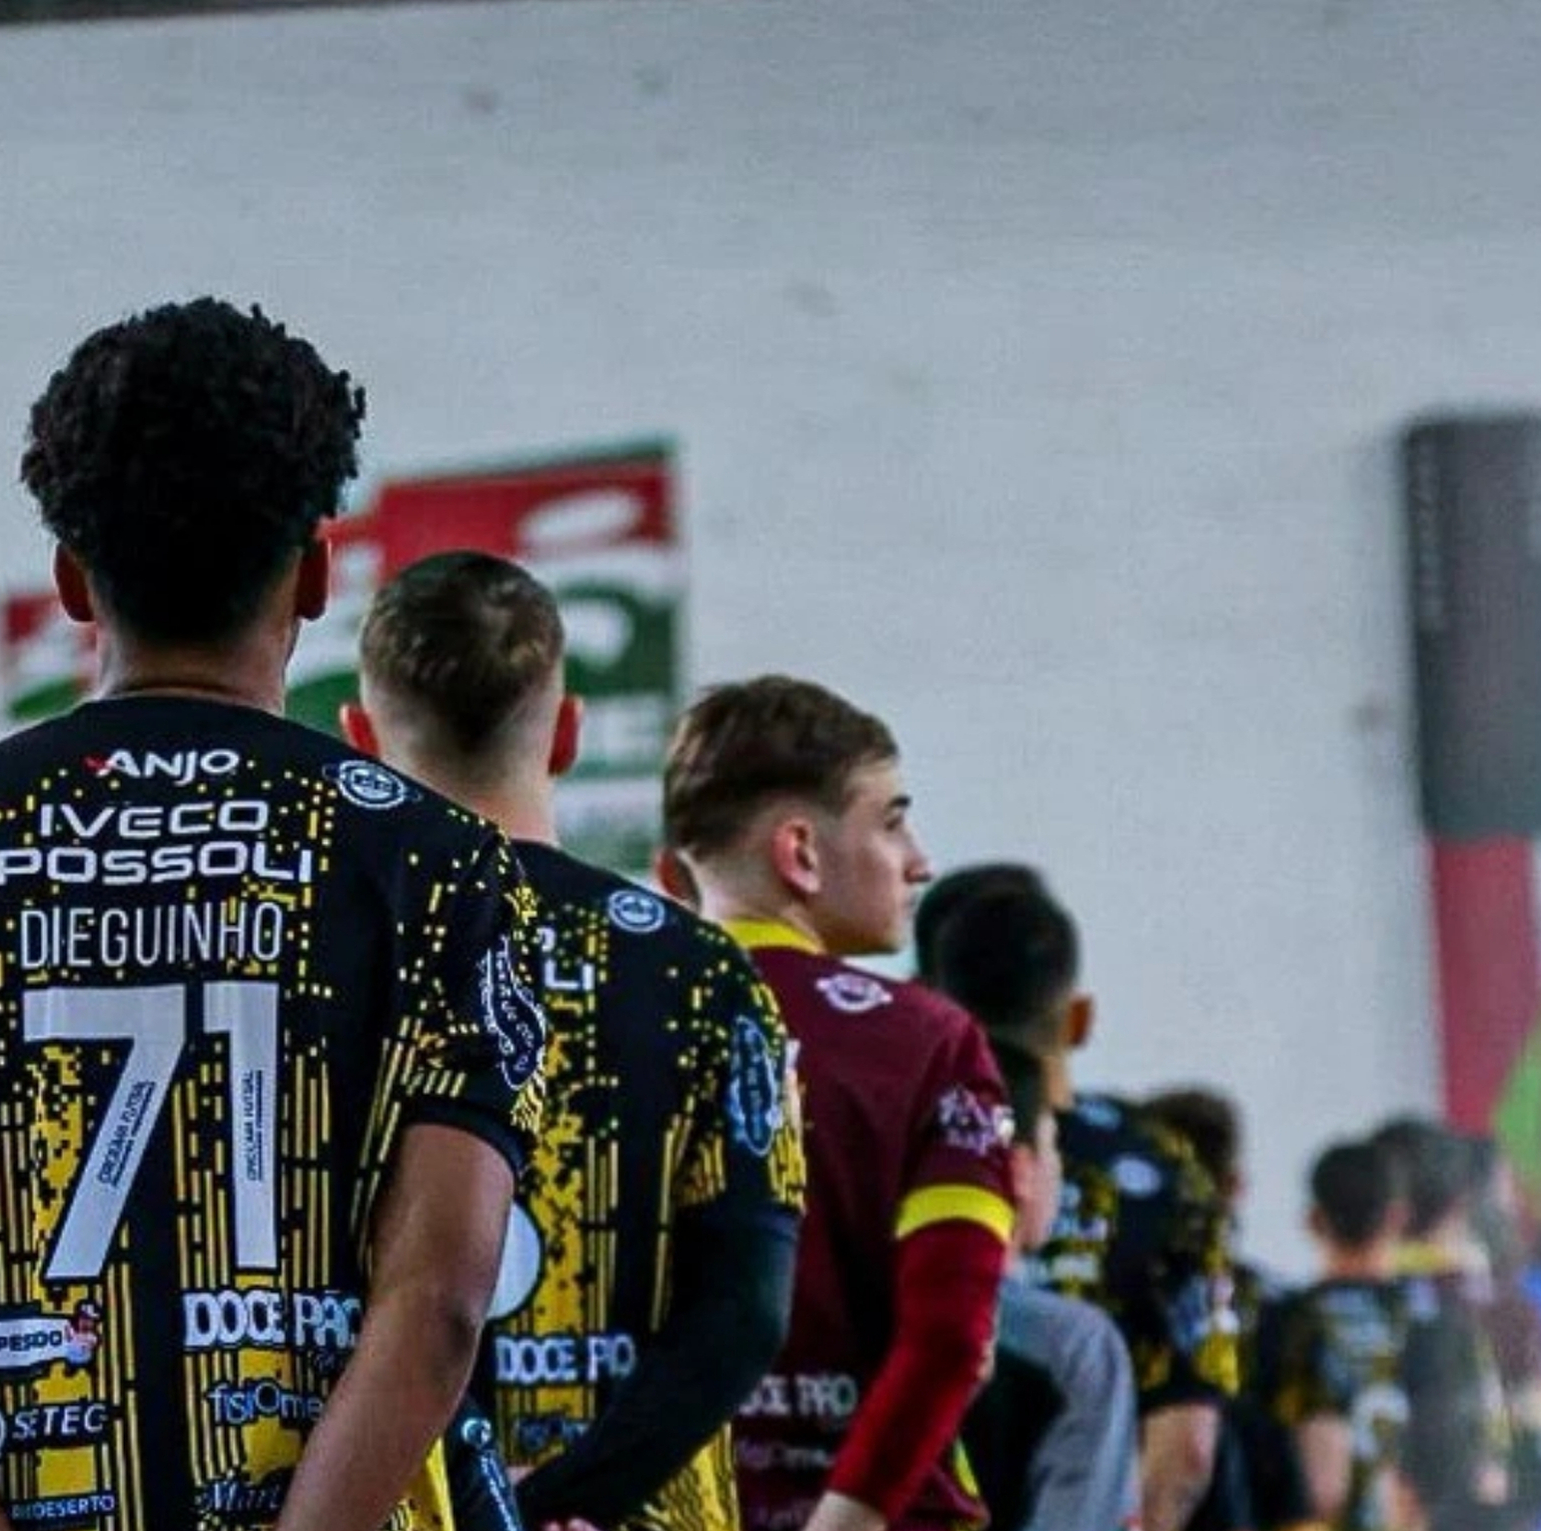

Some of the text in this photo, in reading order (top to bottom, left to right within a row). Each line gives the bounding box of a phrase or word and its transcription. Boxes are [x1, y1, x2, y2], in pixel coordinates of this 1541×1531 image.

[96, 749, 240, 787] ANJO
[40, 800, 269, 839] IVECO
[20, 901, 284, 970] DIEGUINHO
[22, 981, 280, 1281] 71
[184, 1290, 285, 1348] DOCE
[495, 1335, 578, 1385] DOCE
